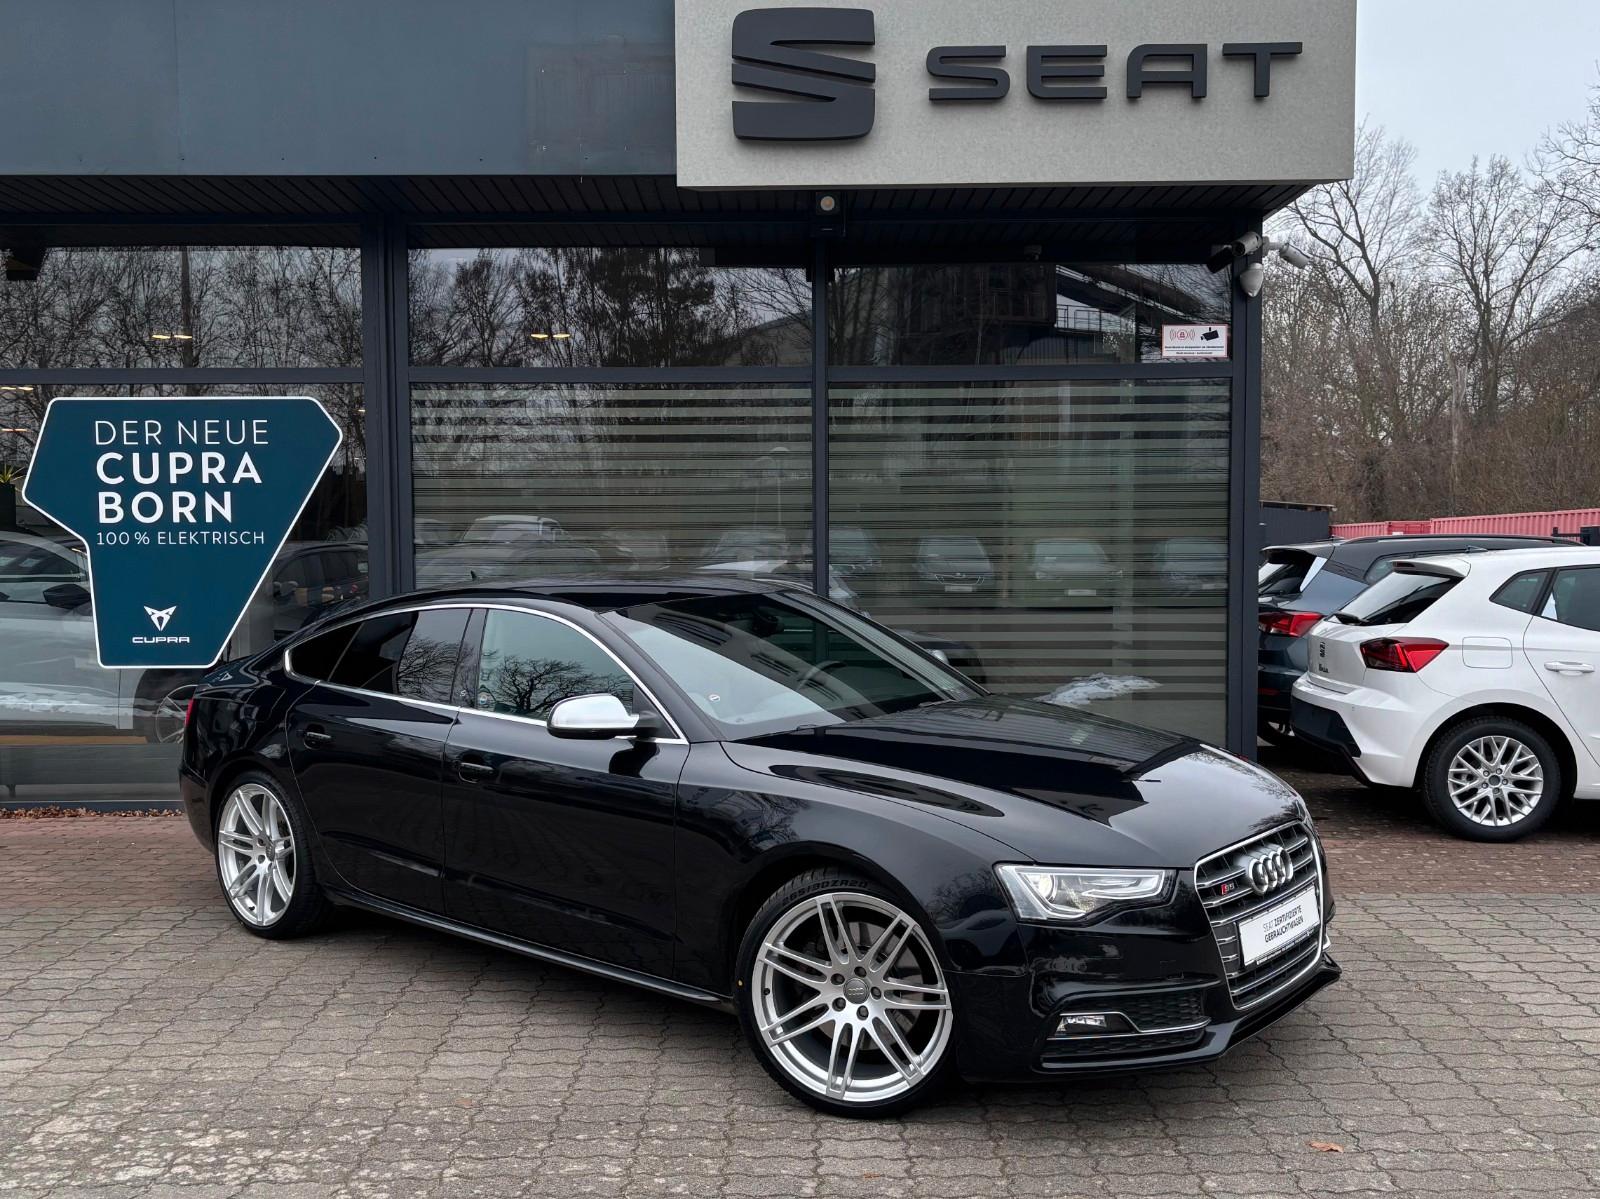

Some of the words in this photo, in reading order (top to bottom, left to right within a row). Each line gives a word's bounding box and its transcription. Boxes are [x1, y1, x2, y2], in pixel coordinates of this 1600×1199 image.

[926, 42, 1303, 101] SEAT
[94, 420, 162, 445] DER
[177, 419, 269, 445] NEUE
[96, 451, 263, 485] CUPRA
[98, 491, 232, 523] BORN
[96, 531, 130, 545] 100
[134, 531, 150, 545] %
[157, 531, 265, 545] ELEKTRISCH
[132, 636, 190, 644] CUPRA
[1264, 915, 1304, 943] GEBRAUCHTWAGEN
